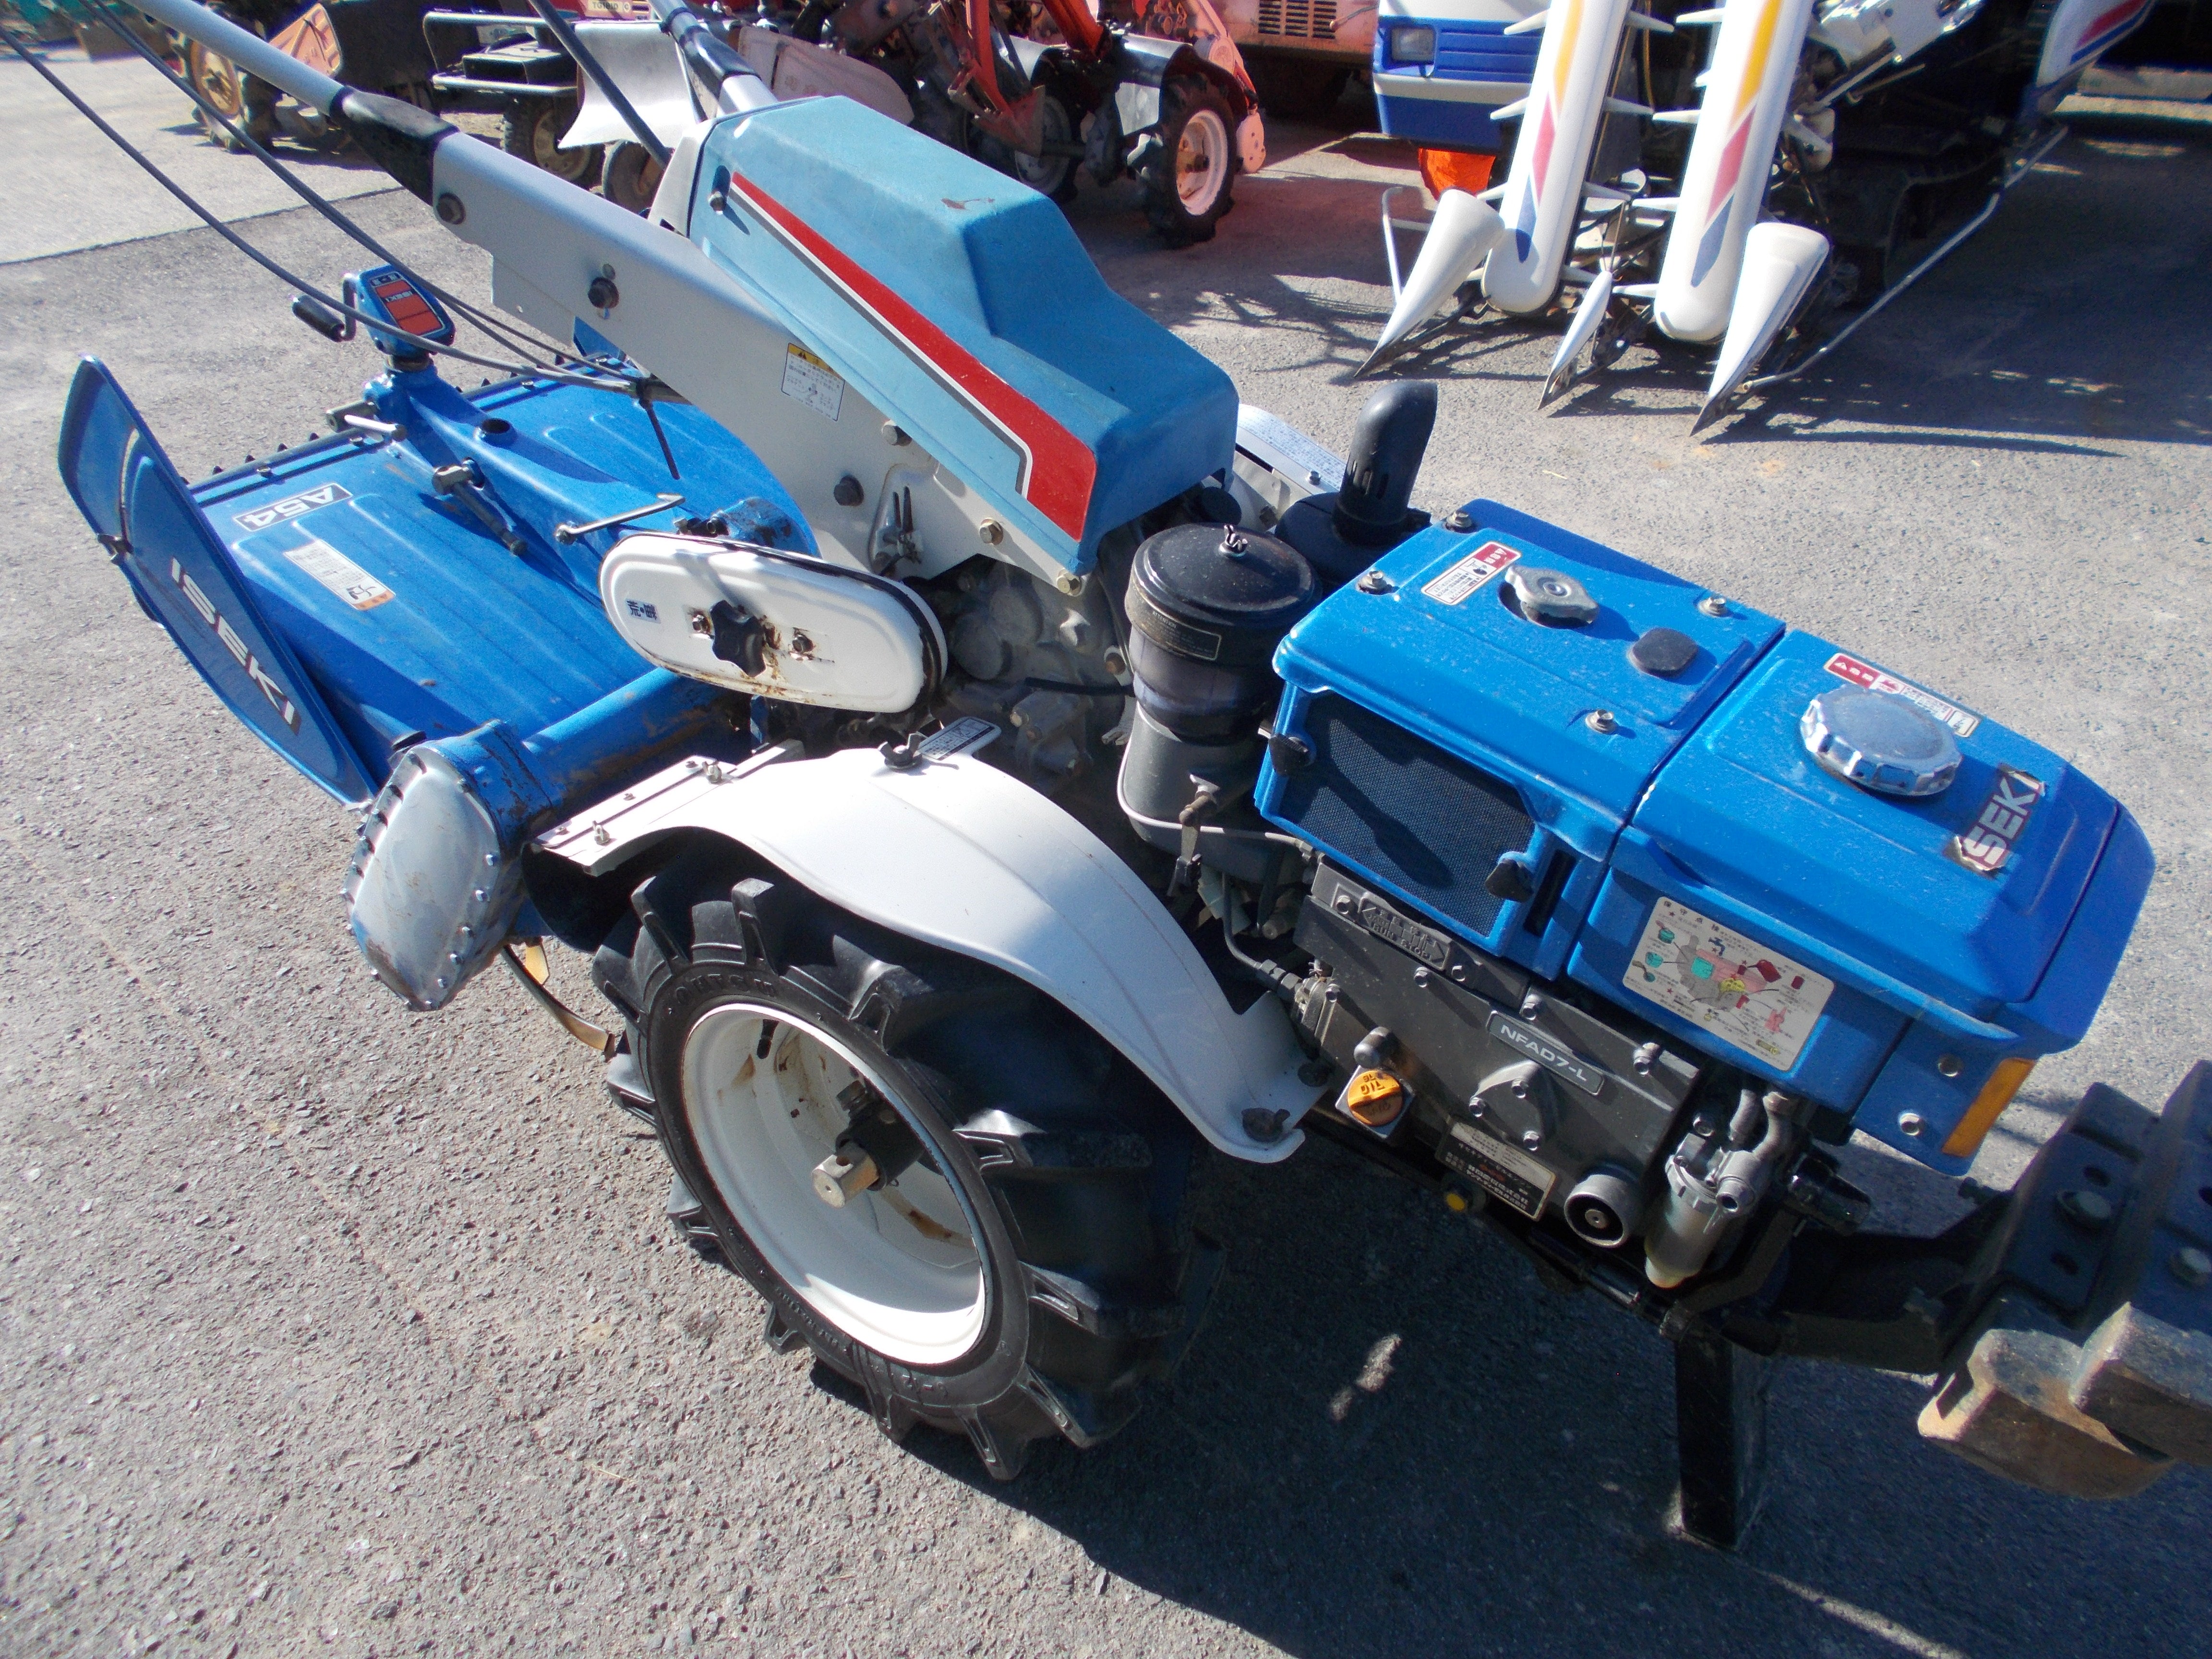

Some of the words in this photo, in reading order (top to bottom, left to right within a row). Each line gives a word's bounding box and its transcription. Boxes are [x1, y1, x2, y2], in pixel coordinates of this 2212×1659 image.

[244, 487, 334, 527] A54
[172, 557, 295, 725] ISEKI
[1153, 611, 1177, 628] ATTENTION
[1963, 771, 2040, 865] SEKI
[1501, 1024, 1587, 1082] NFAD7-L
[1360, 1080, 1386, 1095] OIL
